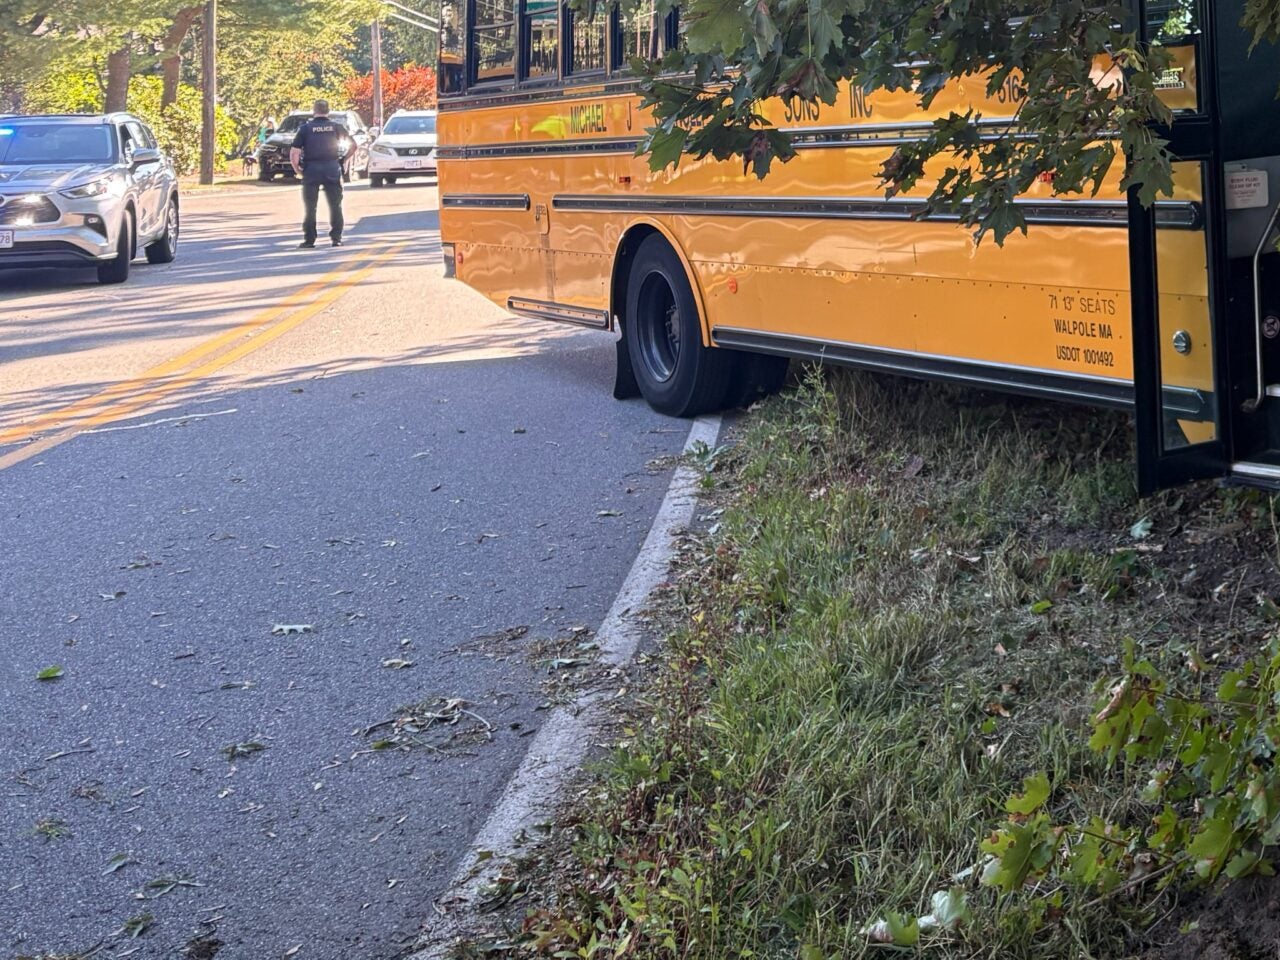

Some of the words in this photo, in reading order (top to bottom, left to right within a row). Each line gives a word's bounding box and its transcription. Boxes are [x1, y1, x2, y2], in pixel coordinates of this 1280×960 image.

[570, 103, 607, 134] MICHAEL
[626, 101, 632, 132] J
[849, 83, 873, 119] INC
[1048, 294, 1058, 309] 71
[1080, 297, 1116, 315] SEATS
[1054, 319, 1096, 337] WALPOLE
[1099, 323, 1113, 339] MA
[1056, 345, 1081, 362] USDOT
[1083, 349, 1114, 367] 1001492
